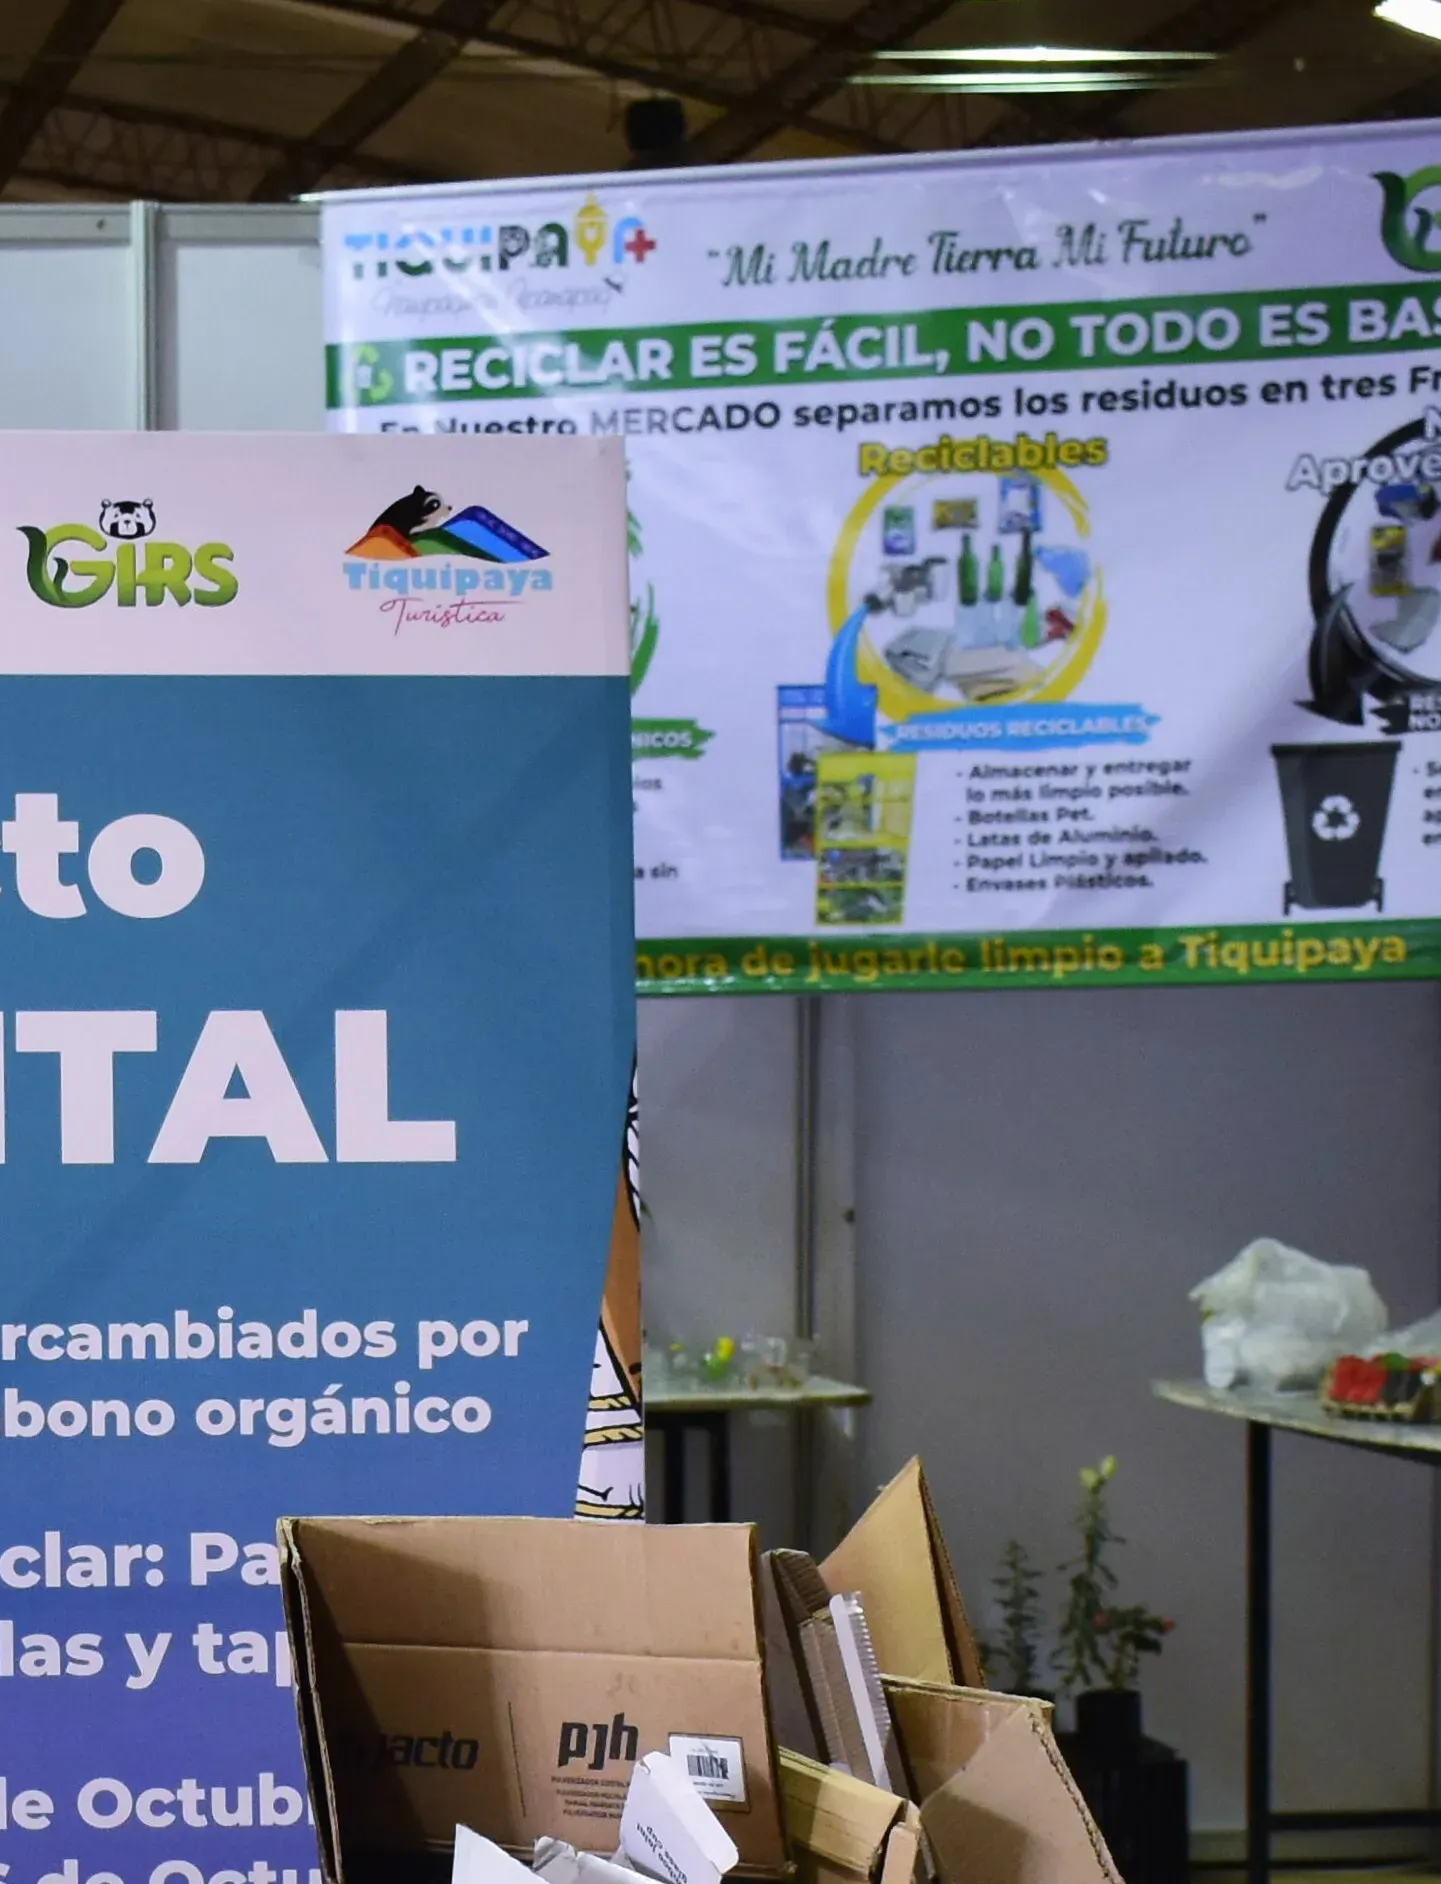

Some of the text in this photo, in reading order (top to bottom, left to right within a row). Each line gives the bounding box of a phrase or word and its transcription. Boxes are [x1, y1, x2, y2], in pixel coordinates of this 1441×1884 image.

[788, 241, 917, 283] Madre
[926, 229, 1039, 275] Tierra
[1053, 223, 1109, 268] Mi
[404, 341, 674, 393] RECICLAR
[690, 332, 757, 377] ES
[773, 317, 949, 375] FÁCIL,
[966, 316, 1053, 364] NO
[1071, 305, 1239, 358] TODO
[1259, 301, 1329, 348] ES
[590, 401, 780, 436] MERCADO
[793, 392, 1001, 433] separamos
[1014, 386, 1069, 415] los
[1081, 377, 1248, 413] residuos
[1260, 378, 1307, 405] en
[1321, 371, 1397, 400] tres
[858, 432, 1108, 478] Reciclables
[15, 522, 240, 608] GIRS
[342, 562, 552, 596] Tiquipaya
[895, 715, 1151, 742] RESIDUOS RECICLABLES
[1409, 713, 1441, 731] NO
[741, 930, 1408, 983] de jugarle limpio a Tiquipaya
[418, 1314, 529, 1374] por
[194, 1380, 492, 1451] orgánico
[123, 1632, 172, 1689] y
